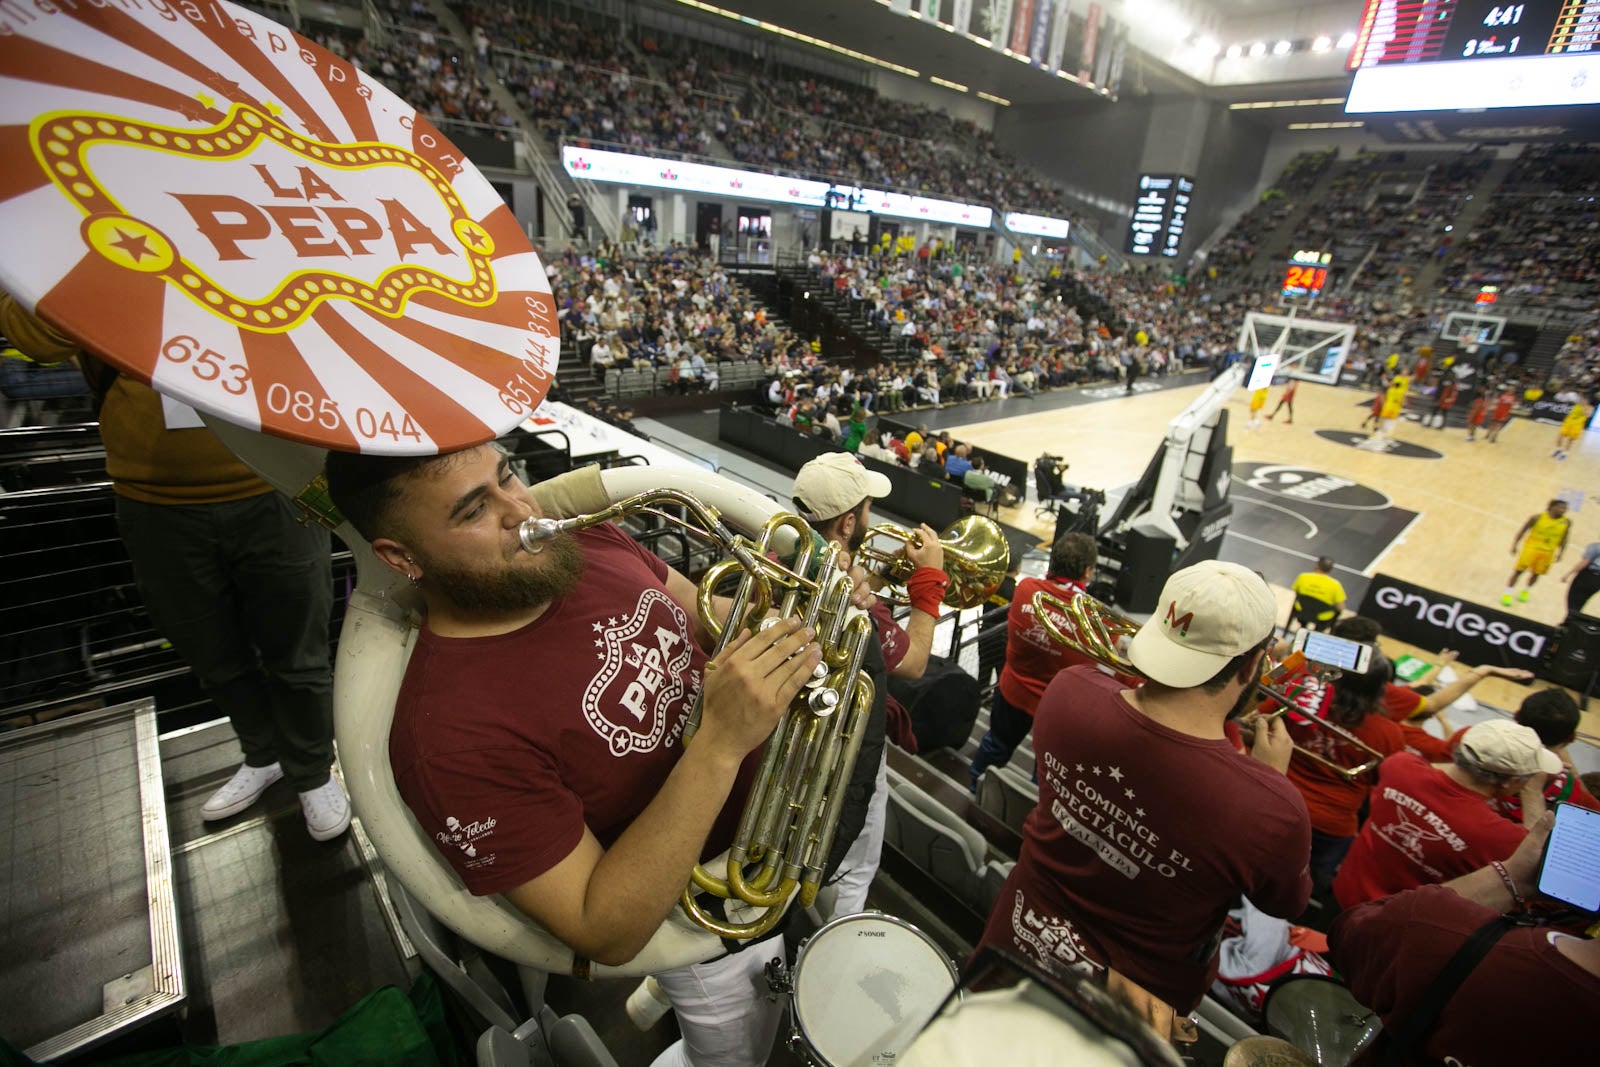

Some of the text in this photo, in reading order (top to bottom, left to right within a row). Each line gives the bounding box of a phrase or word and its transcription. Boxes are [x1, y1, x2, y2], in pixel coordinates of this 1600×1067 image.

[1483, 4, 1524, 27] 4:41
[1509, 36, 1520, 53] 1
[251, 163, 344, 202] LA
[165, 191, 459, 261] PEPA
[1284, 266, 1315, 288] 24
[162, 334, 423, 444] 653 085 044
[499, 296, 552, 415] 651 044 318
[624, 642, 648, 669] LA
[1375, 586, 1547, 658] endesa
[619, 626, 681, 724] PEPA
[664, 669, 701, 748] CHARANGA
[462, 816, 497, 840] Toledo
[1044, 751, 1194, 872] QUE COMIENCE EL
[1045, 771, 1177, 879] ESPECTÁCULO
